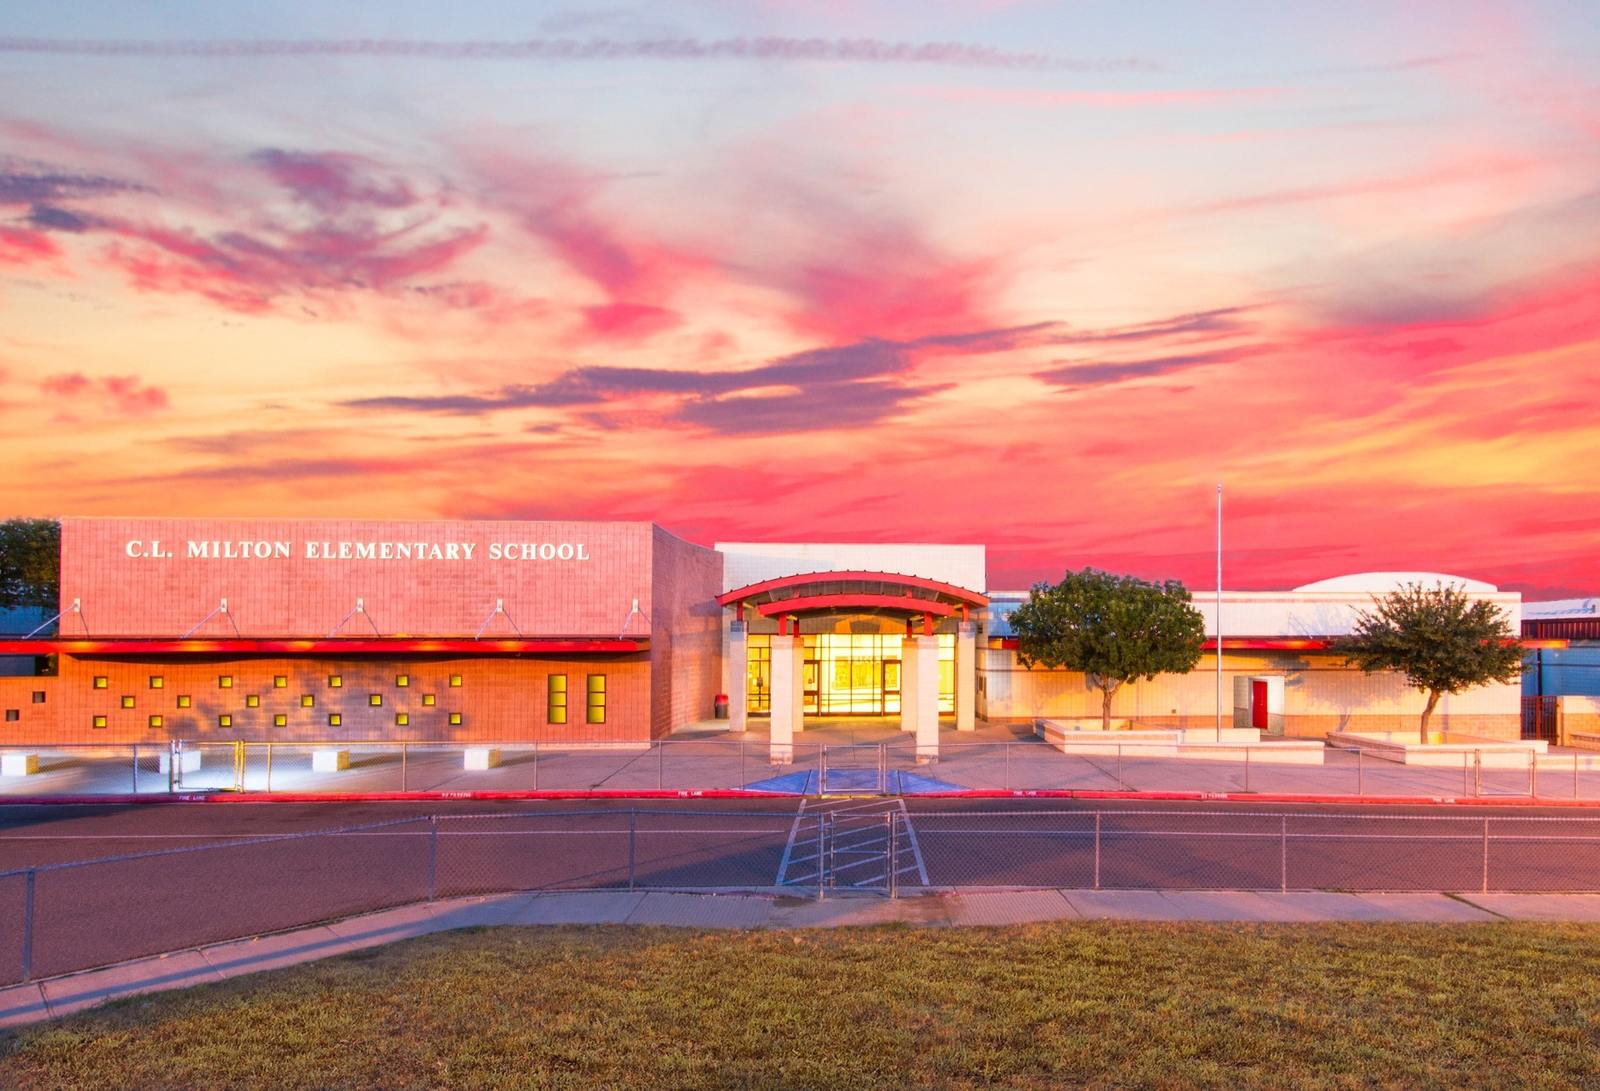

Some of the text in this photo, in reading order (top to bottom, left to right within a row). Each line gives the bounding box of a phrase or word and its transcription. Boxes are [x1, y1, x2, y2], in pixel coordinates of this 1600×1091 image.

[125, 540, 590, 561] C.L. MILTON ELEMENTARY SCHOOL
